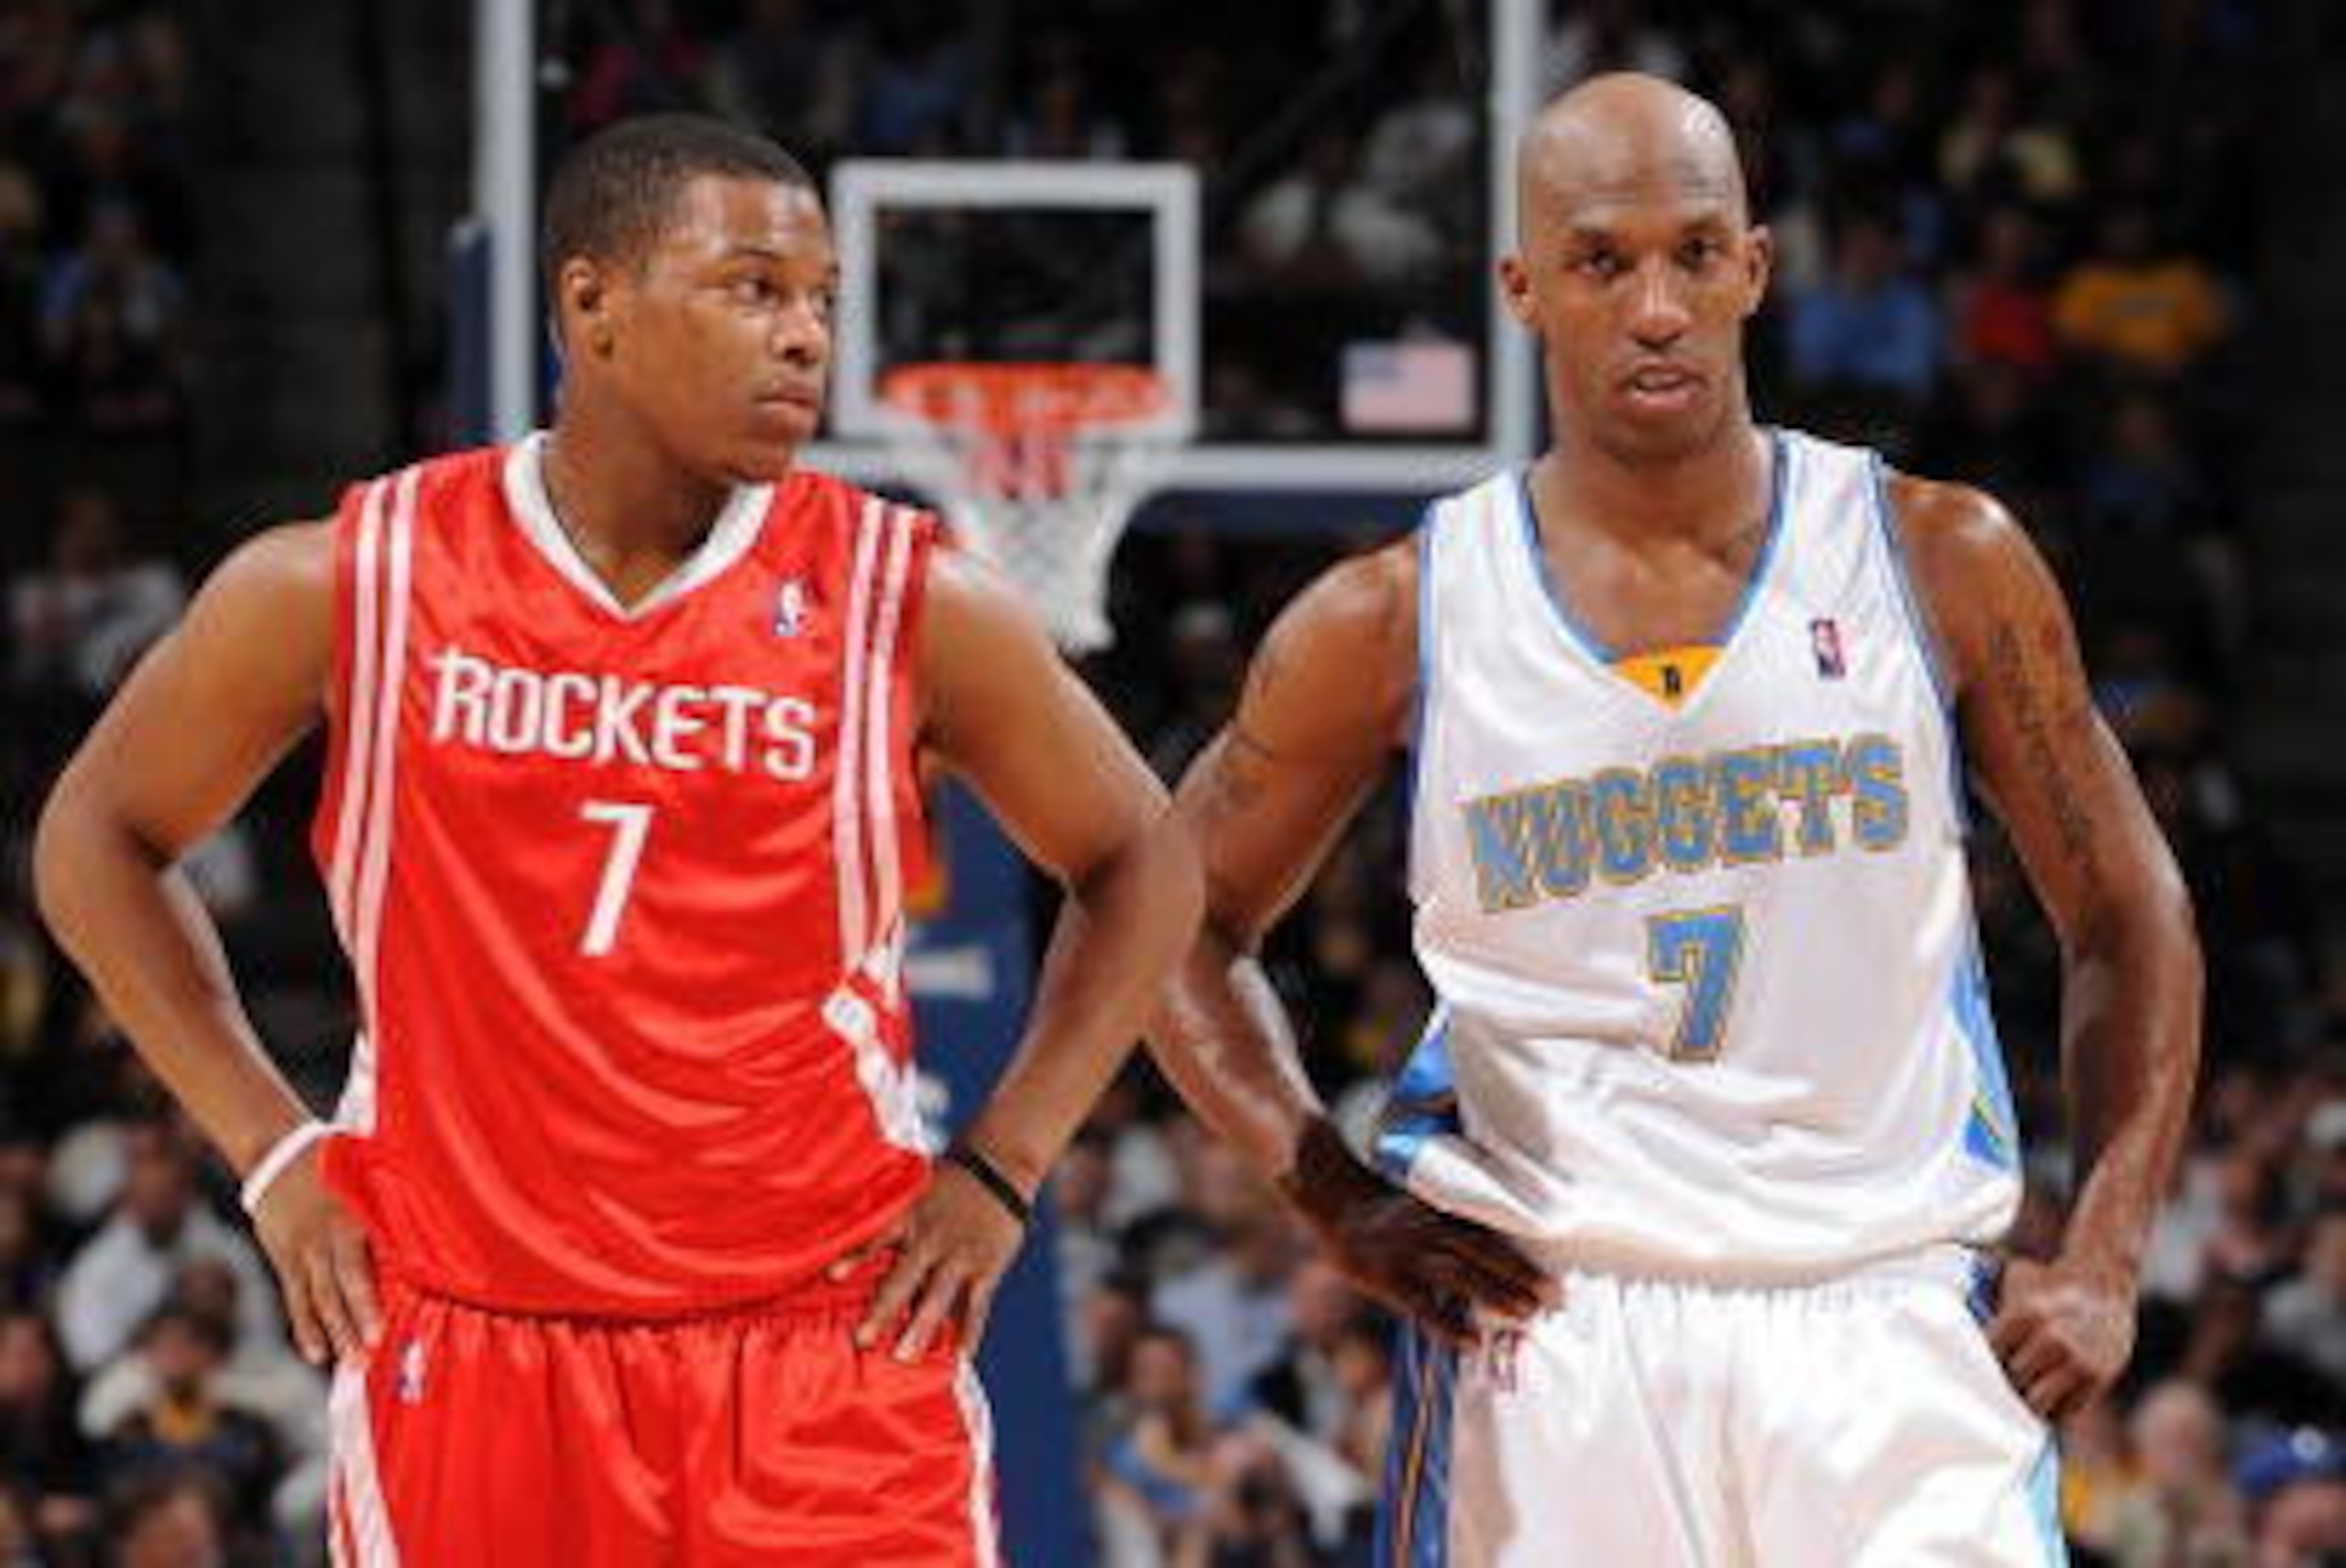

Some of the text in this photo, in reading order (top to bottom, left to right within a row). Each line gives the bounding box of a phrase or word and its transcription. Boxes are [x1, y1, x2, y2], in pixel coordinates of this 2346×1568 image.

[430, 648, 815, 780] ROCKETS
[580, 801, 652, 956] 7
[1464, 736, 1908, 914] NUGGETS
[1647, 905, 1743, 1062] 7
